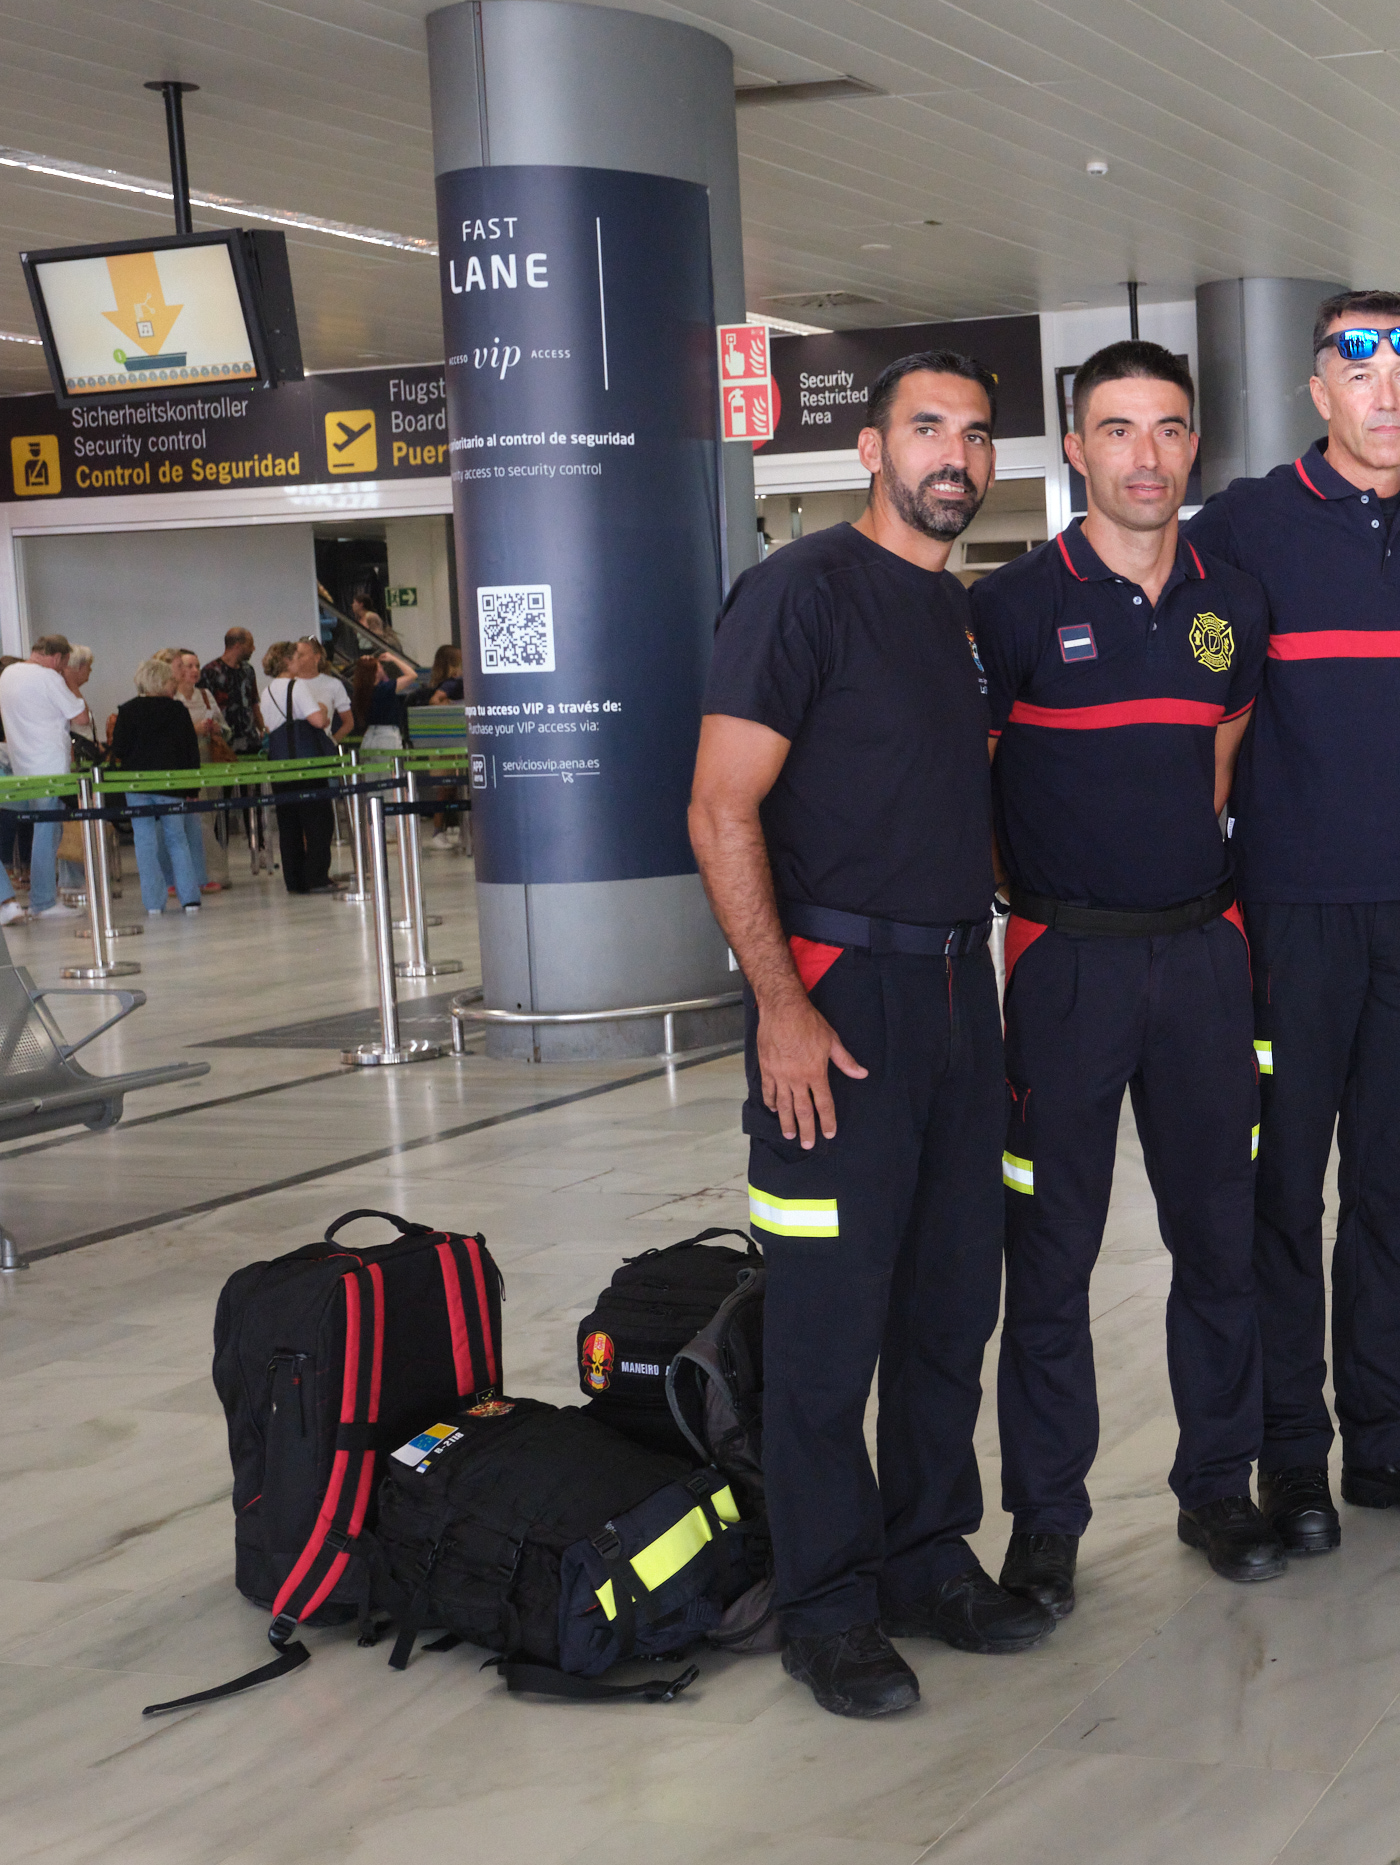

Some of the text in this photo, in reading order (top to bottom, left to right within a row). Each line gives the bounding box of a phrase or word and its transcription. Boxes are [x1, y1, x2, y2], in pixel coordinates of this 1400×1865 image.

[462, 217, 518, 242] FAST
[449, 252, 549, 294] LANE
[472, 337, 522, 380] vip
[530, 349, 571, 359] ACCESS
[800, 369, 854, 389] Security
[800, 386, 869, 407] Restricted
[72, 396, 249, 428] Sicherheitskontroller
[391, 407, 446, 433] Board
[801, 409, 832, 426] Area
[74, 428, 207, 457] Security control
[486, 433, 497, 448] al
[499, 431, 546, 446] control
[549, 431, 567, 445] de
[570, 431, 636, 448] seguridad
[392, 441, 449, 467] Puer
[75, 451, 301, 488] Control de Seguridad
[464, 466, 492, 480] access
[493, 463, 506, 477] to
[508, 462, 556, 478] security
[559, 462, 602, 476] control
[477, 704, 486, 717] tu
[487, 703, 520, 716] acceso
[522, 702, 544, 715] VIP
[547, 704, 555, 715] a
[558, 700, 600, 714] través
[602, 699, 623, 713] de:
[494, 723, 514, 738] your
[516, 721, 536, 734] VIP
[538, 722, 577, 733] access
[579, 720, 600, 732] via:
[502, 757, 600, 773] serviciosvip.aena.es
[621, 1361, 660, 1376] MANEIRO
